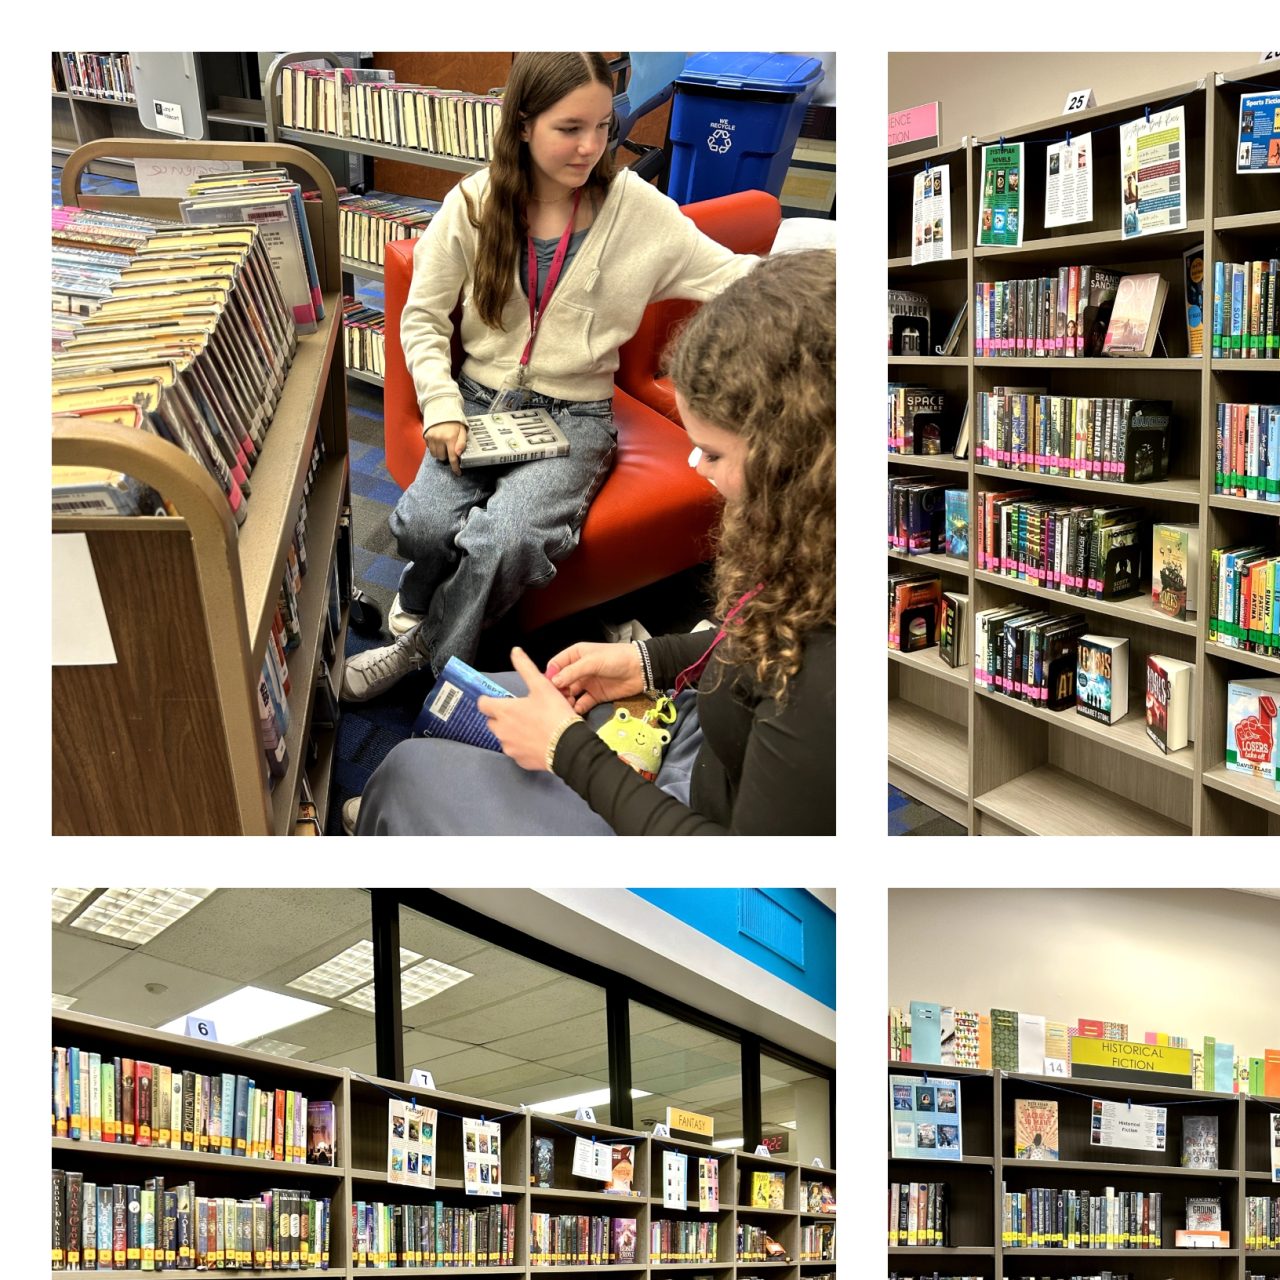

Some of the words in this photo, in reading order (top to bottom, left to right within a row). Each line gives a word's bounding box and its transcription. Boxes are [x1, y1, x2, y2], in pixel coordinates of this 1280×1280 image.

[1069, 95, 1085, 110] 25
[1246, 98, 1264, 107] Sports
[710, 123, 736, 132] RECYCLE
[1232, 307, 1241, 332] SOAR
[907, 395, 944, 406] SPACE
[511, 411, 557, 445] EXILE
[1093, 405, 1103, 457] ICEBREAKER
[1085, 422, 1094, 456] MINERS
[1241, 741, 1269, 753] LOSERS
[1236, 761, 1253, 770] DAVID
[198, 1022, 209, 1036] 6
[1102, 1042, 1164, 1059] HISTORICAL
[1048, 1061, 1063, 1074] 14
[1112, 1057, 1155, 1071] FICTION
[421, 1074, 429, 1085] 7
[583, 1110, 592, 1120] 8
[677, 1115, 707, 1132] FANTASY
[1192, 1205, 1217, 1214] GROUND
